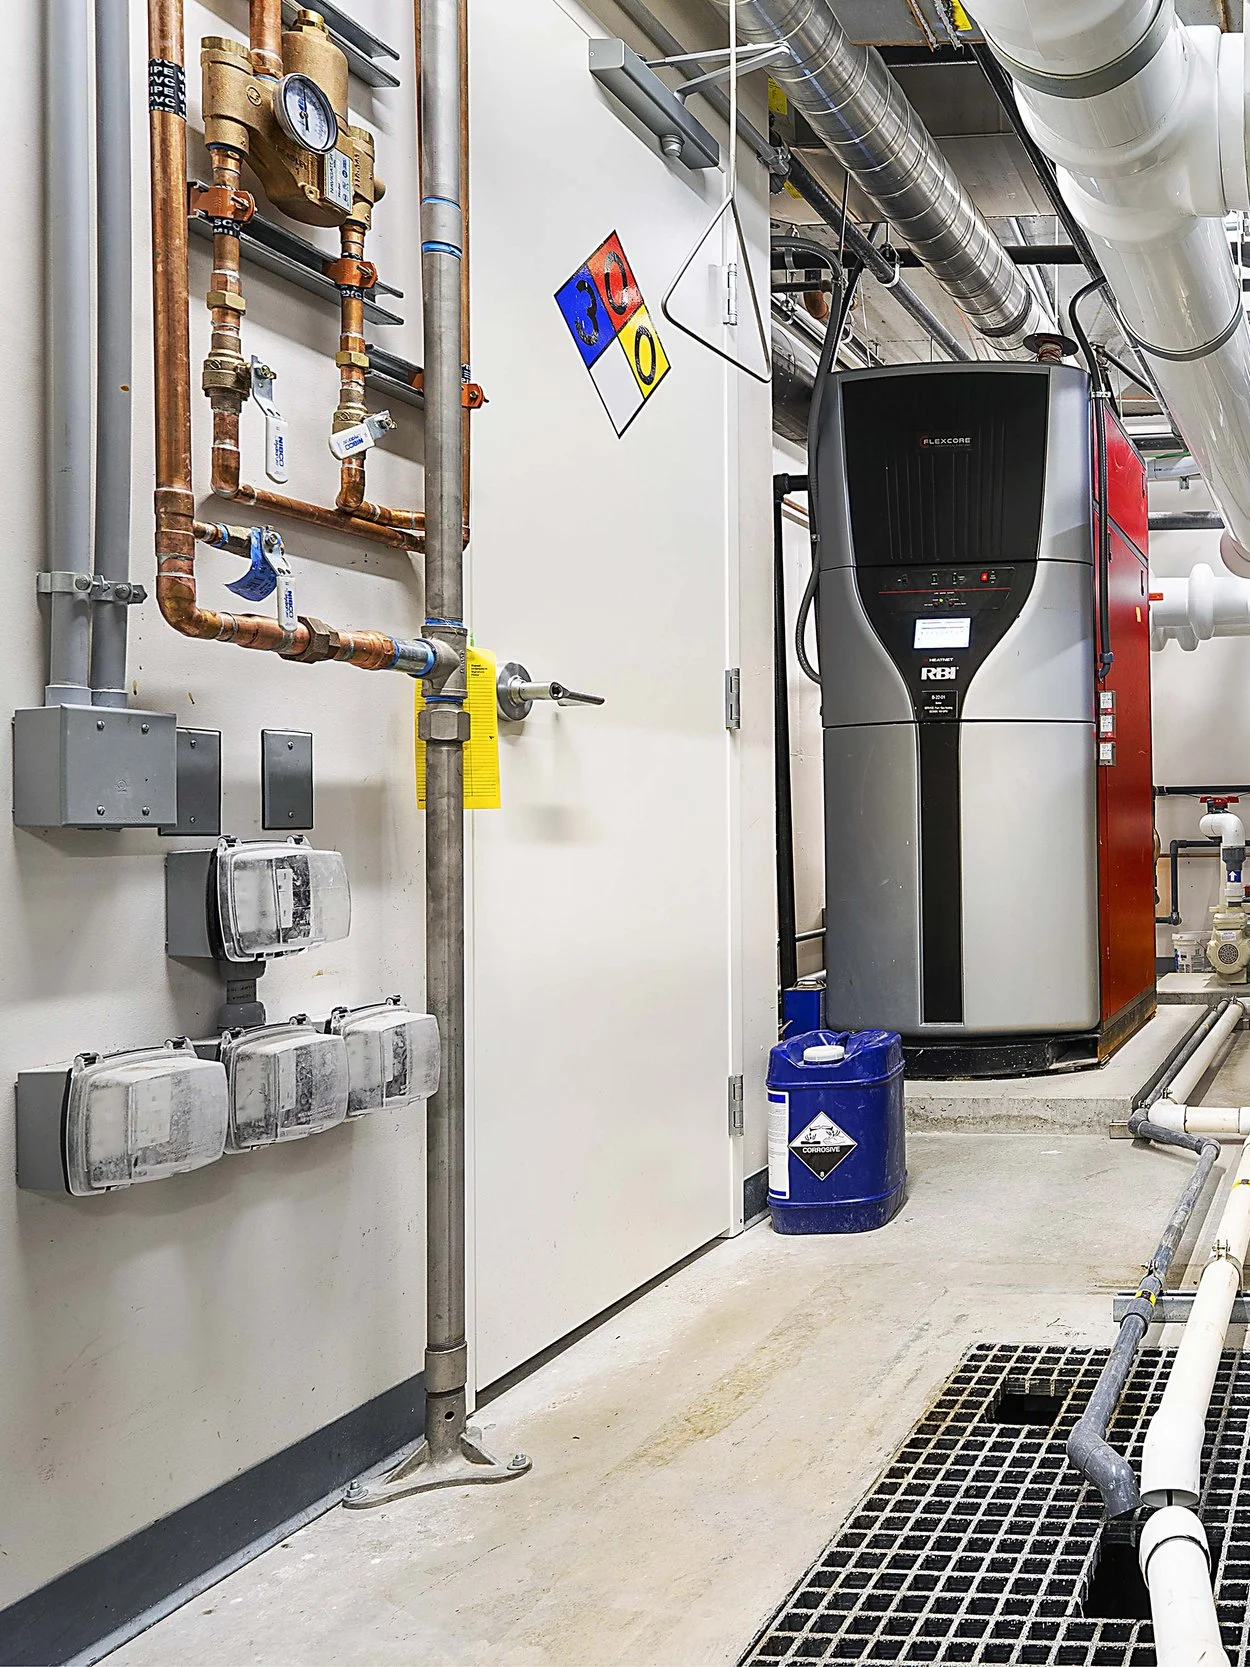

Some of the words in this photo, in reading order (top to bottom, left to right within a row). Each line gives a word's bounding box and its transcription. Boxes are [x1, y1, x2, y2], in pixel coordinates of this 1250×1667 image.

[574, 279, 599, 347] 3
[634, 324, 657, 386] 0
[923, 437, 971, 445] FLEXCORE
[921, 667, 956, 680] RBI
[802, 1146, 840, 1154] CORROSIVE
